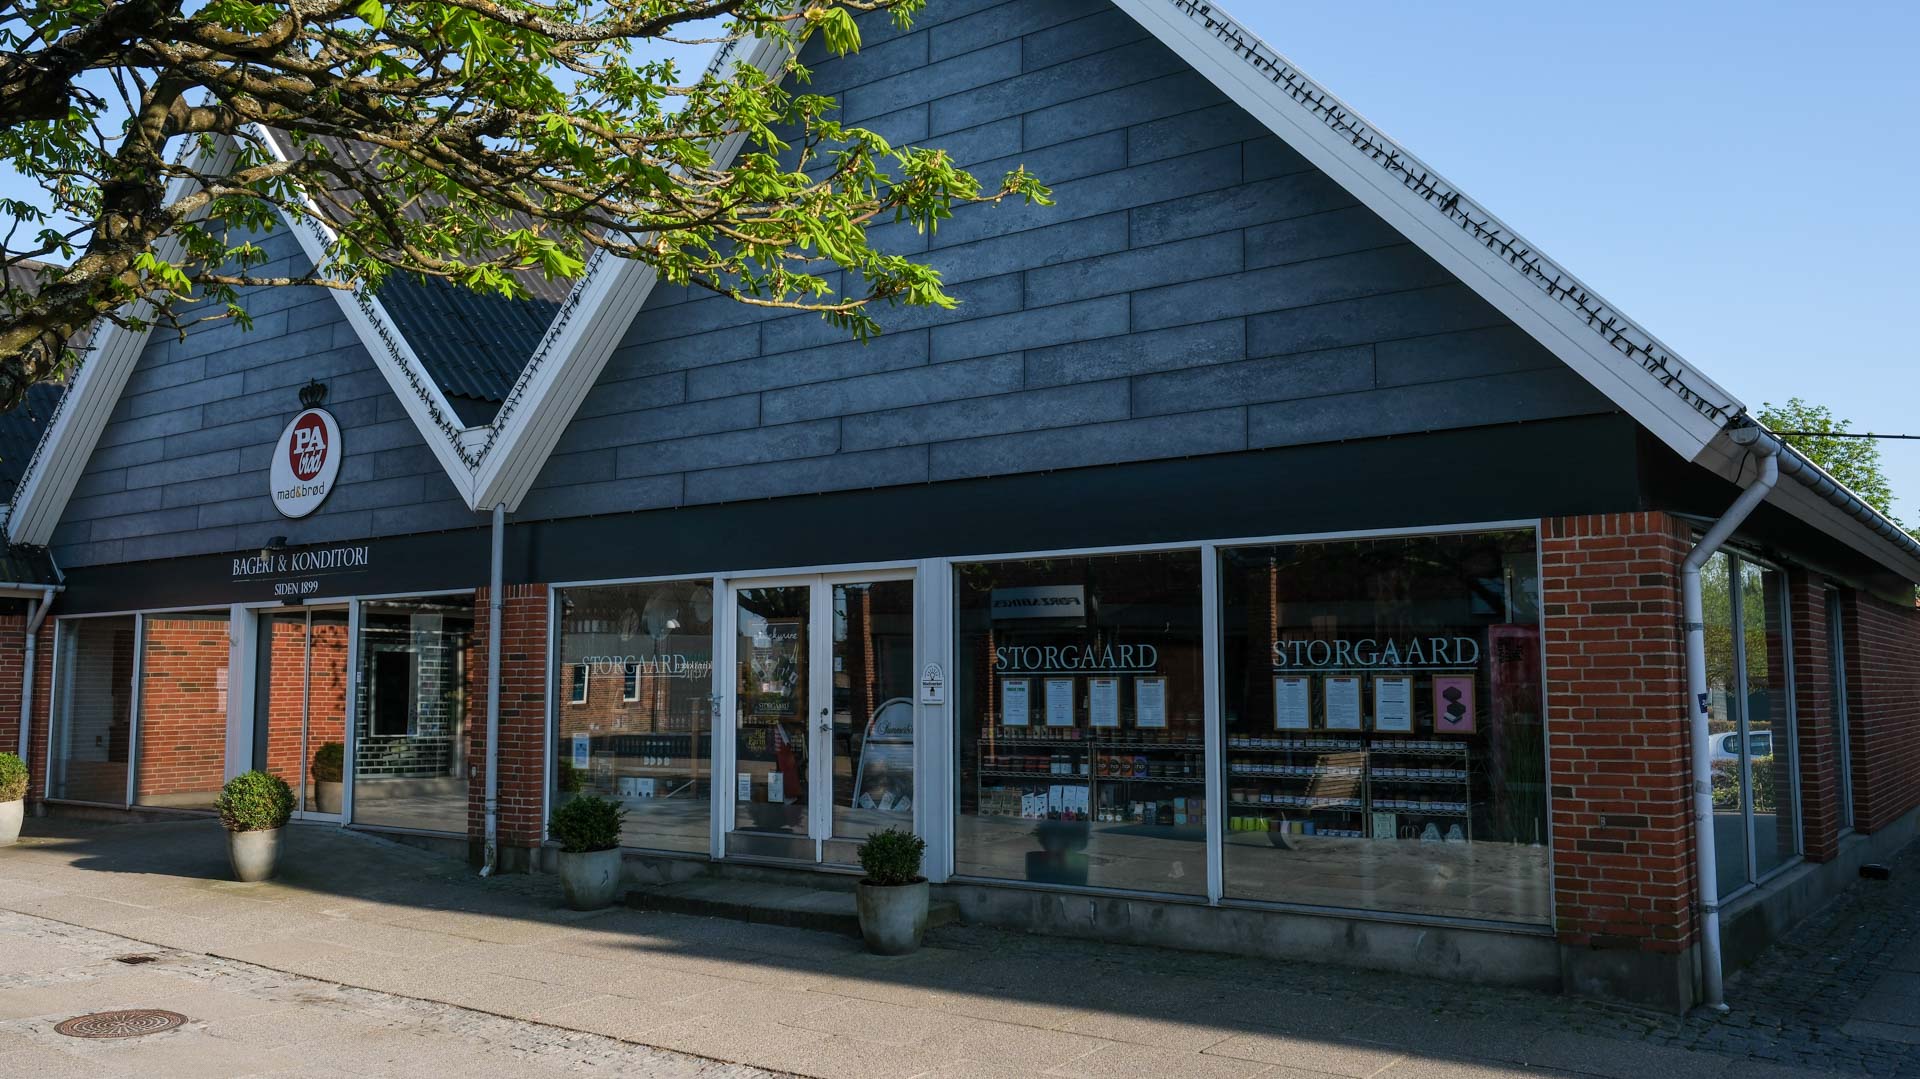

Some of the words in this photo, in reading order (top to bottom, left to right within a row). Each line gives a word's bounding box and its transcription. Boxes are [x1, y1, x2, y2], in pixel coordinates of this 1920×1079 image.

[293, 425, 327, 455] PA
[277, 481, 325, 501] mad&brød
[277, 553, 287, 572] &
[291, 547, 369, 571] KONDITORI
[274, 582, 299, 596] SIDEN
[300, 580, 319, 594] 1899
[995, 643, 1158, 670] STORGAARD
[1272, 636, 1480, 667] STORGAARD
[582, 654, 687, 675] STORGAARD
